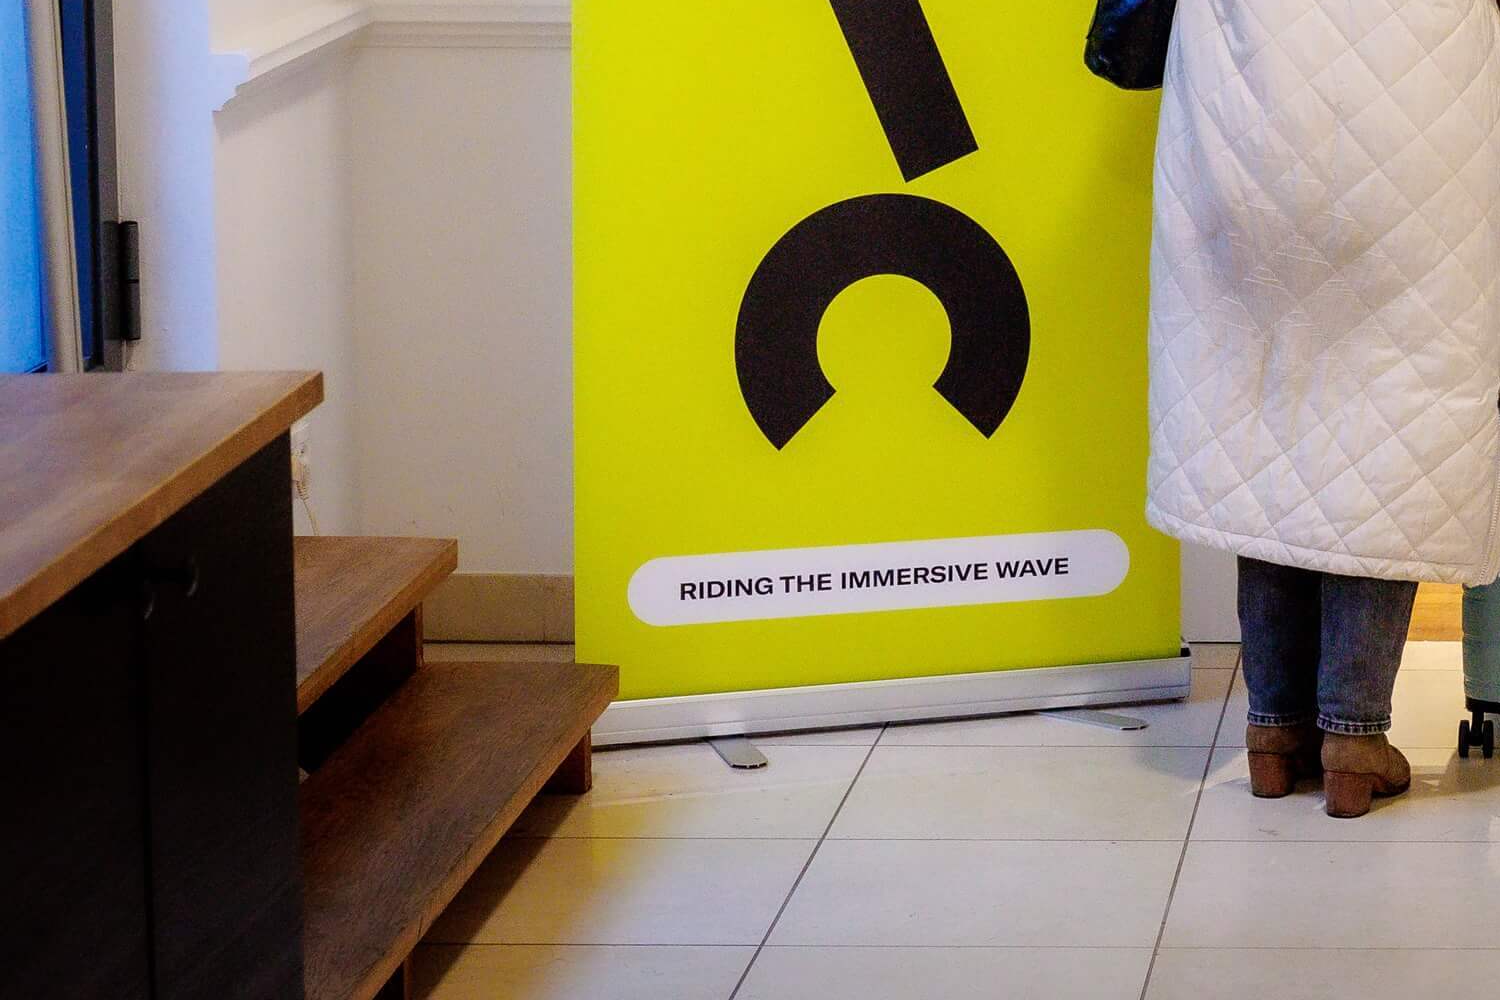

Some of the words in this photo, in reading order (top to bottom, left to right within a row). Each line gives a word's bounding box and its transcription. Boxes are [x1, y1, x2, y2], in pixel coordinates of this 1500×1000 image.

[680, 576, 774, 601] RIDING
[779, 573, 832, 594] THE
[841, 562, 989, 590] IMMERSIVE
[995, 557, 1069, 579] WAVE
